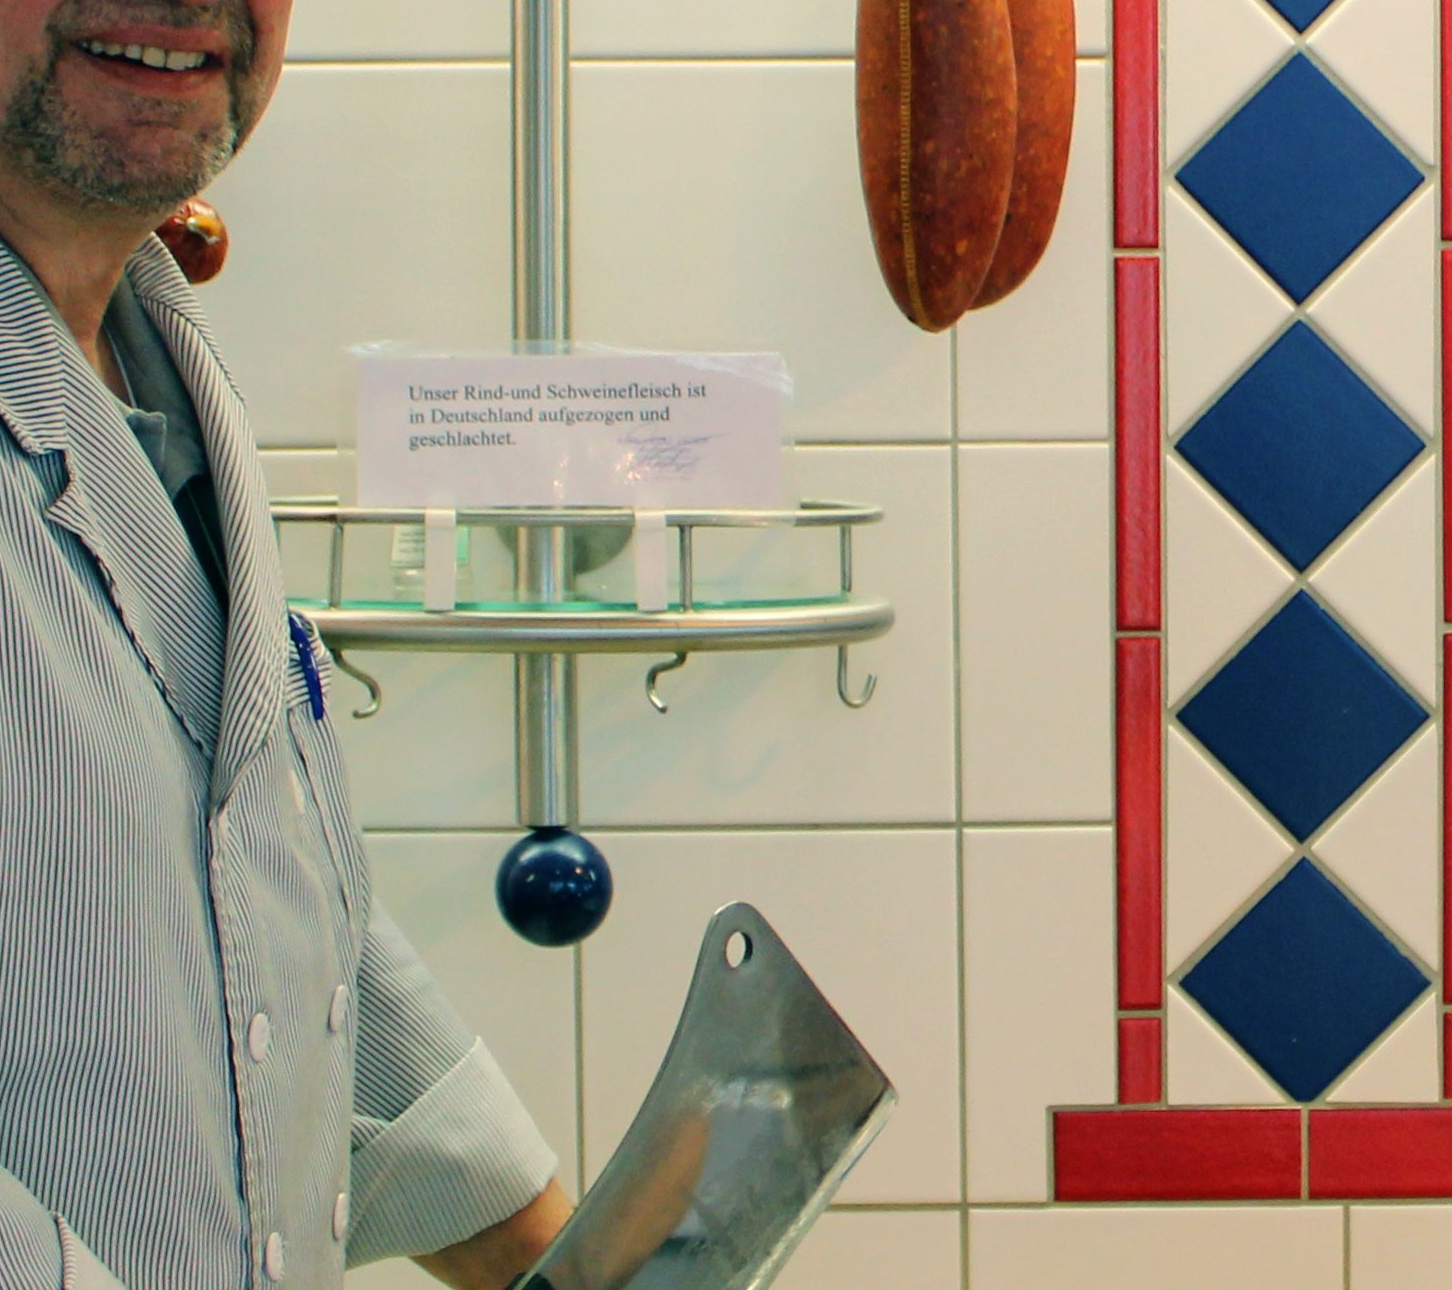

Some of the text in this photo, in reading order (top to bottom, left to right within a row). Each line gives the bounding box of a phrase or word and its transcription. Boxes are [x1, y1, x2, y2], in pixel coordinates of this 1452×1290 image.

[407, 380, 708, 403] Unser Rind-und Schweinefleisch ist
[408, 404, 671, 428] in Deutschland aufgezogen und
[407, 429, 517, 451] geschlachtet.
